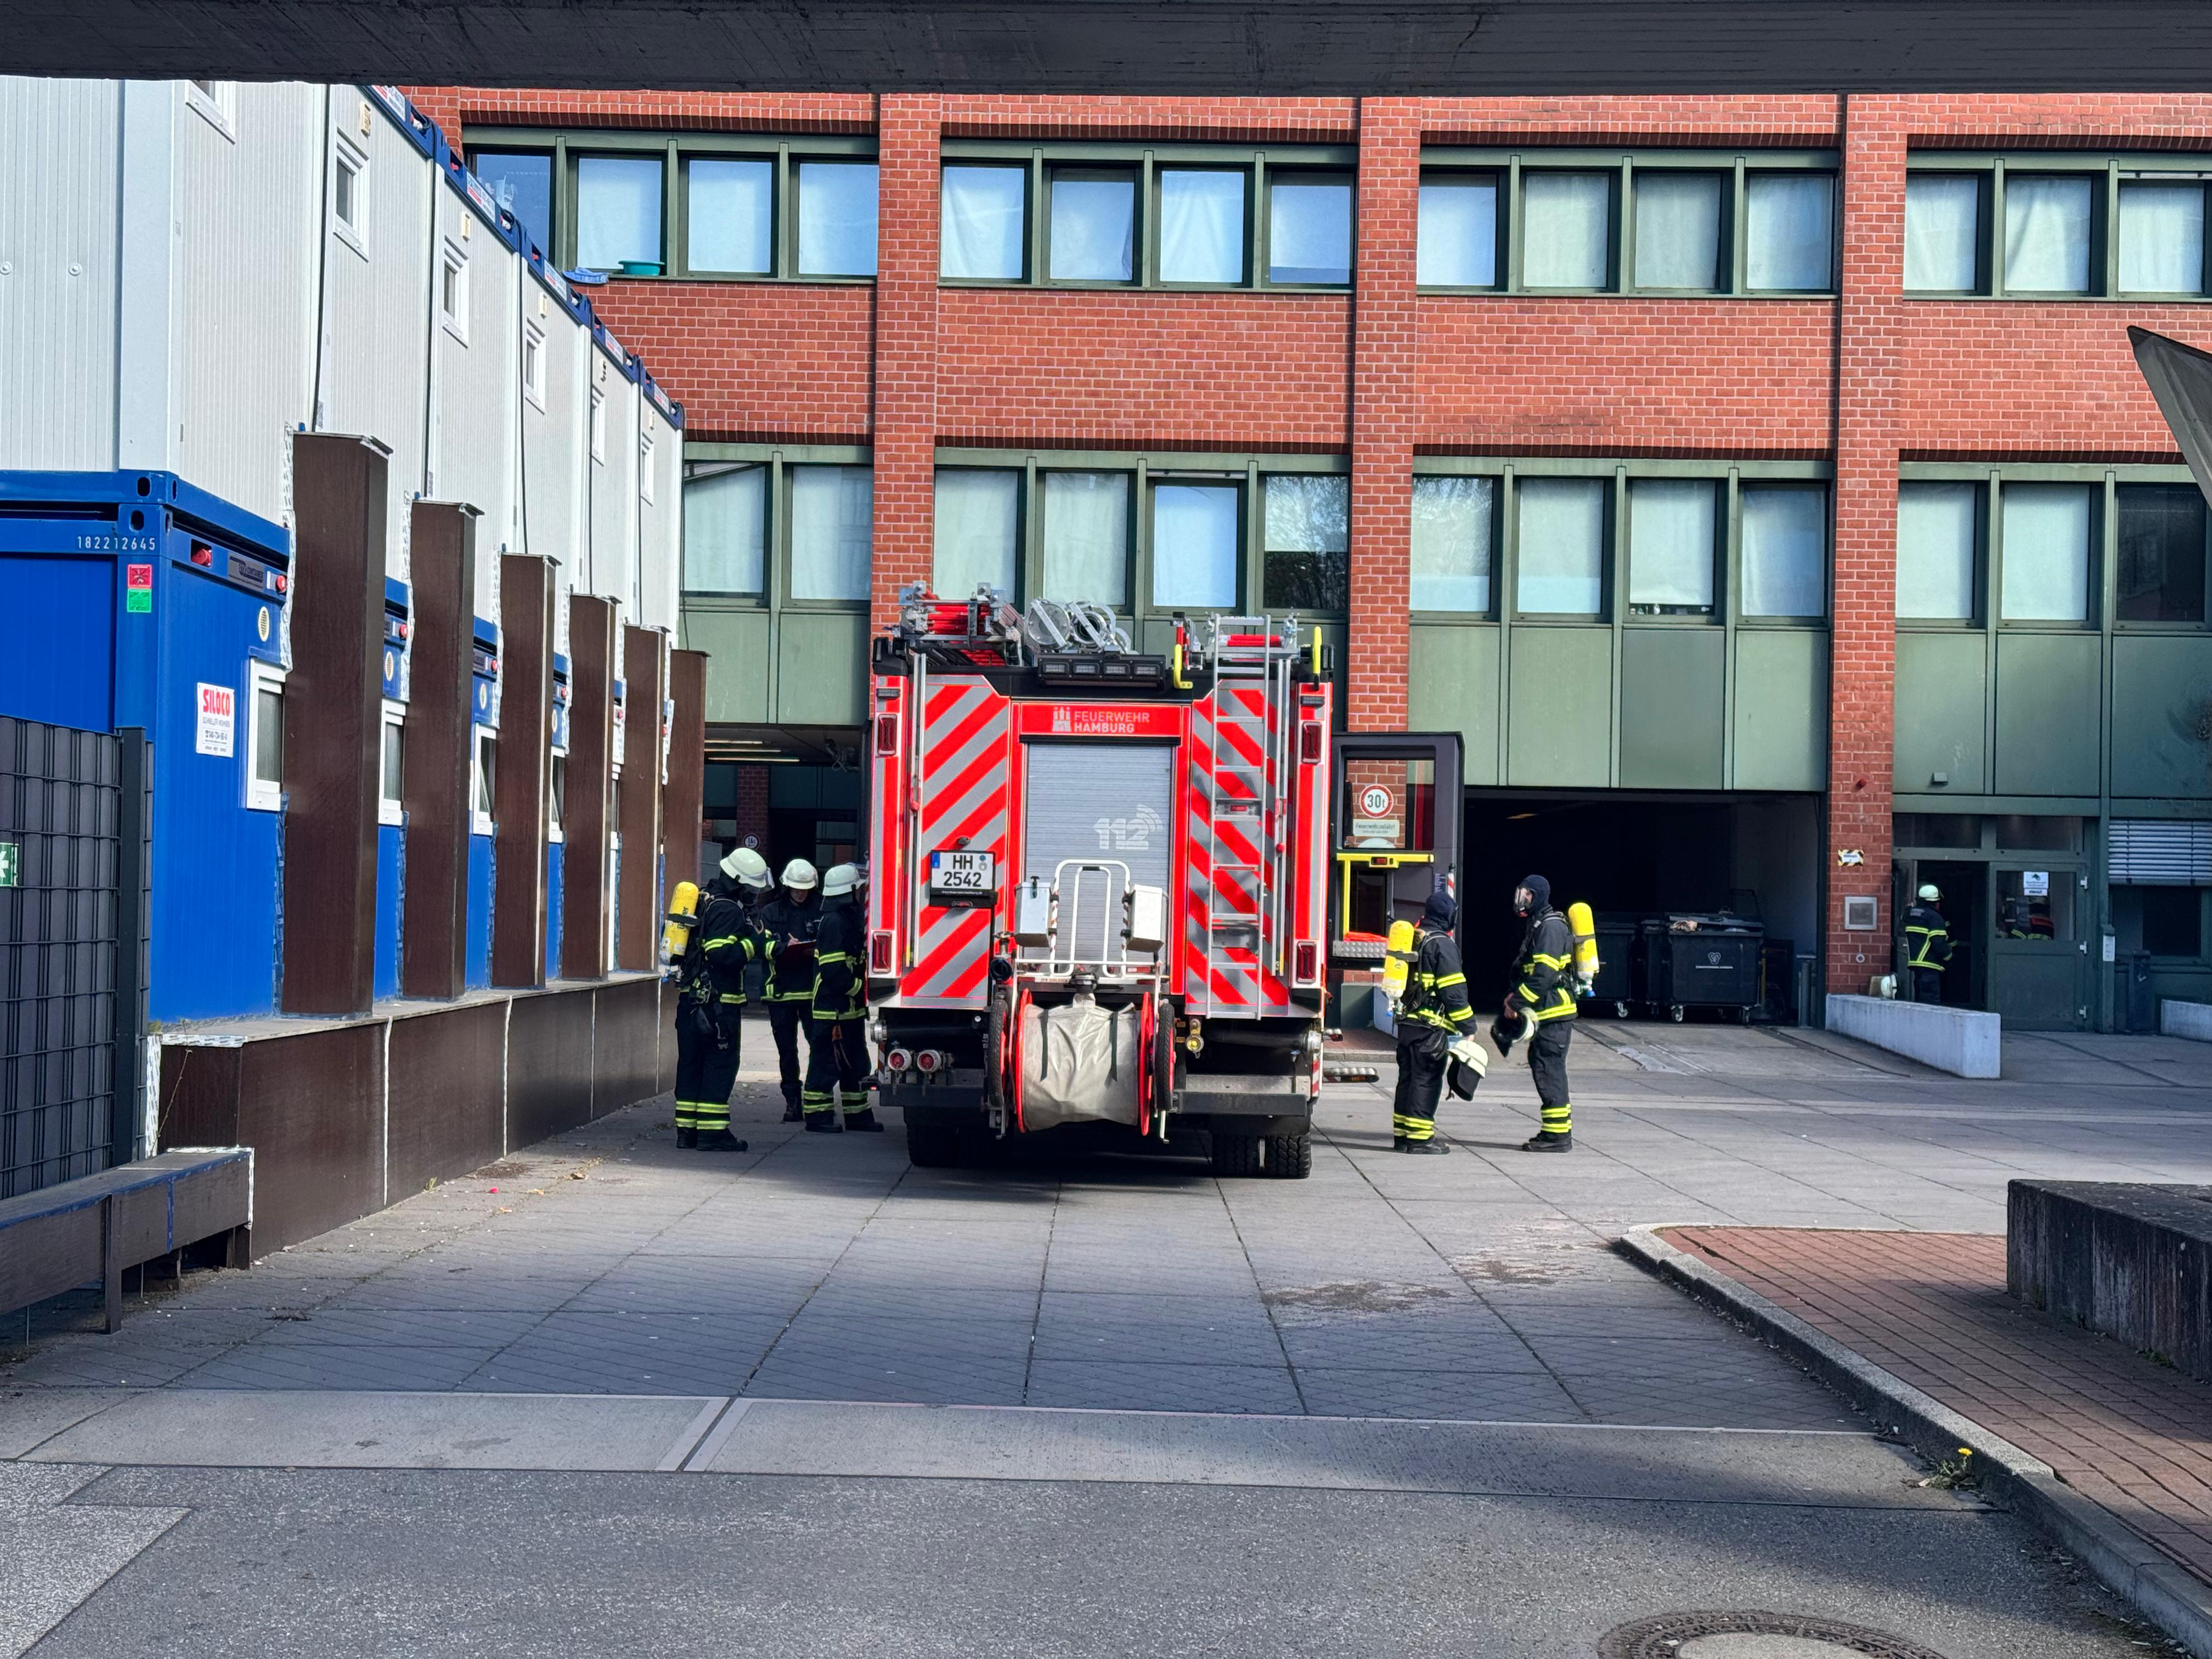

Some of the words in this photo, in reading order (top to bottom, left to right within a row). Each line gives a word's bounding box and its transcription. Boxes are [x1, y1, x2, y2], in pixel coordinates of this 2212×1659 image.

[77, 535, 155, 550] 182212645
[203, 689, 230, 716] SILOCO
[1074, 711, 1150, 723] FEUERWEHR
[1074, 723, 1135, 733] HAMBURG
[1092, 818, 1149, 850] 112
[953, 855, 973, 870] HH
[944, 871, 982, 887] 2542
